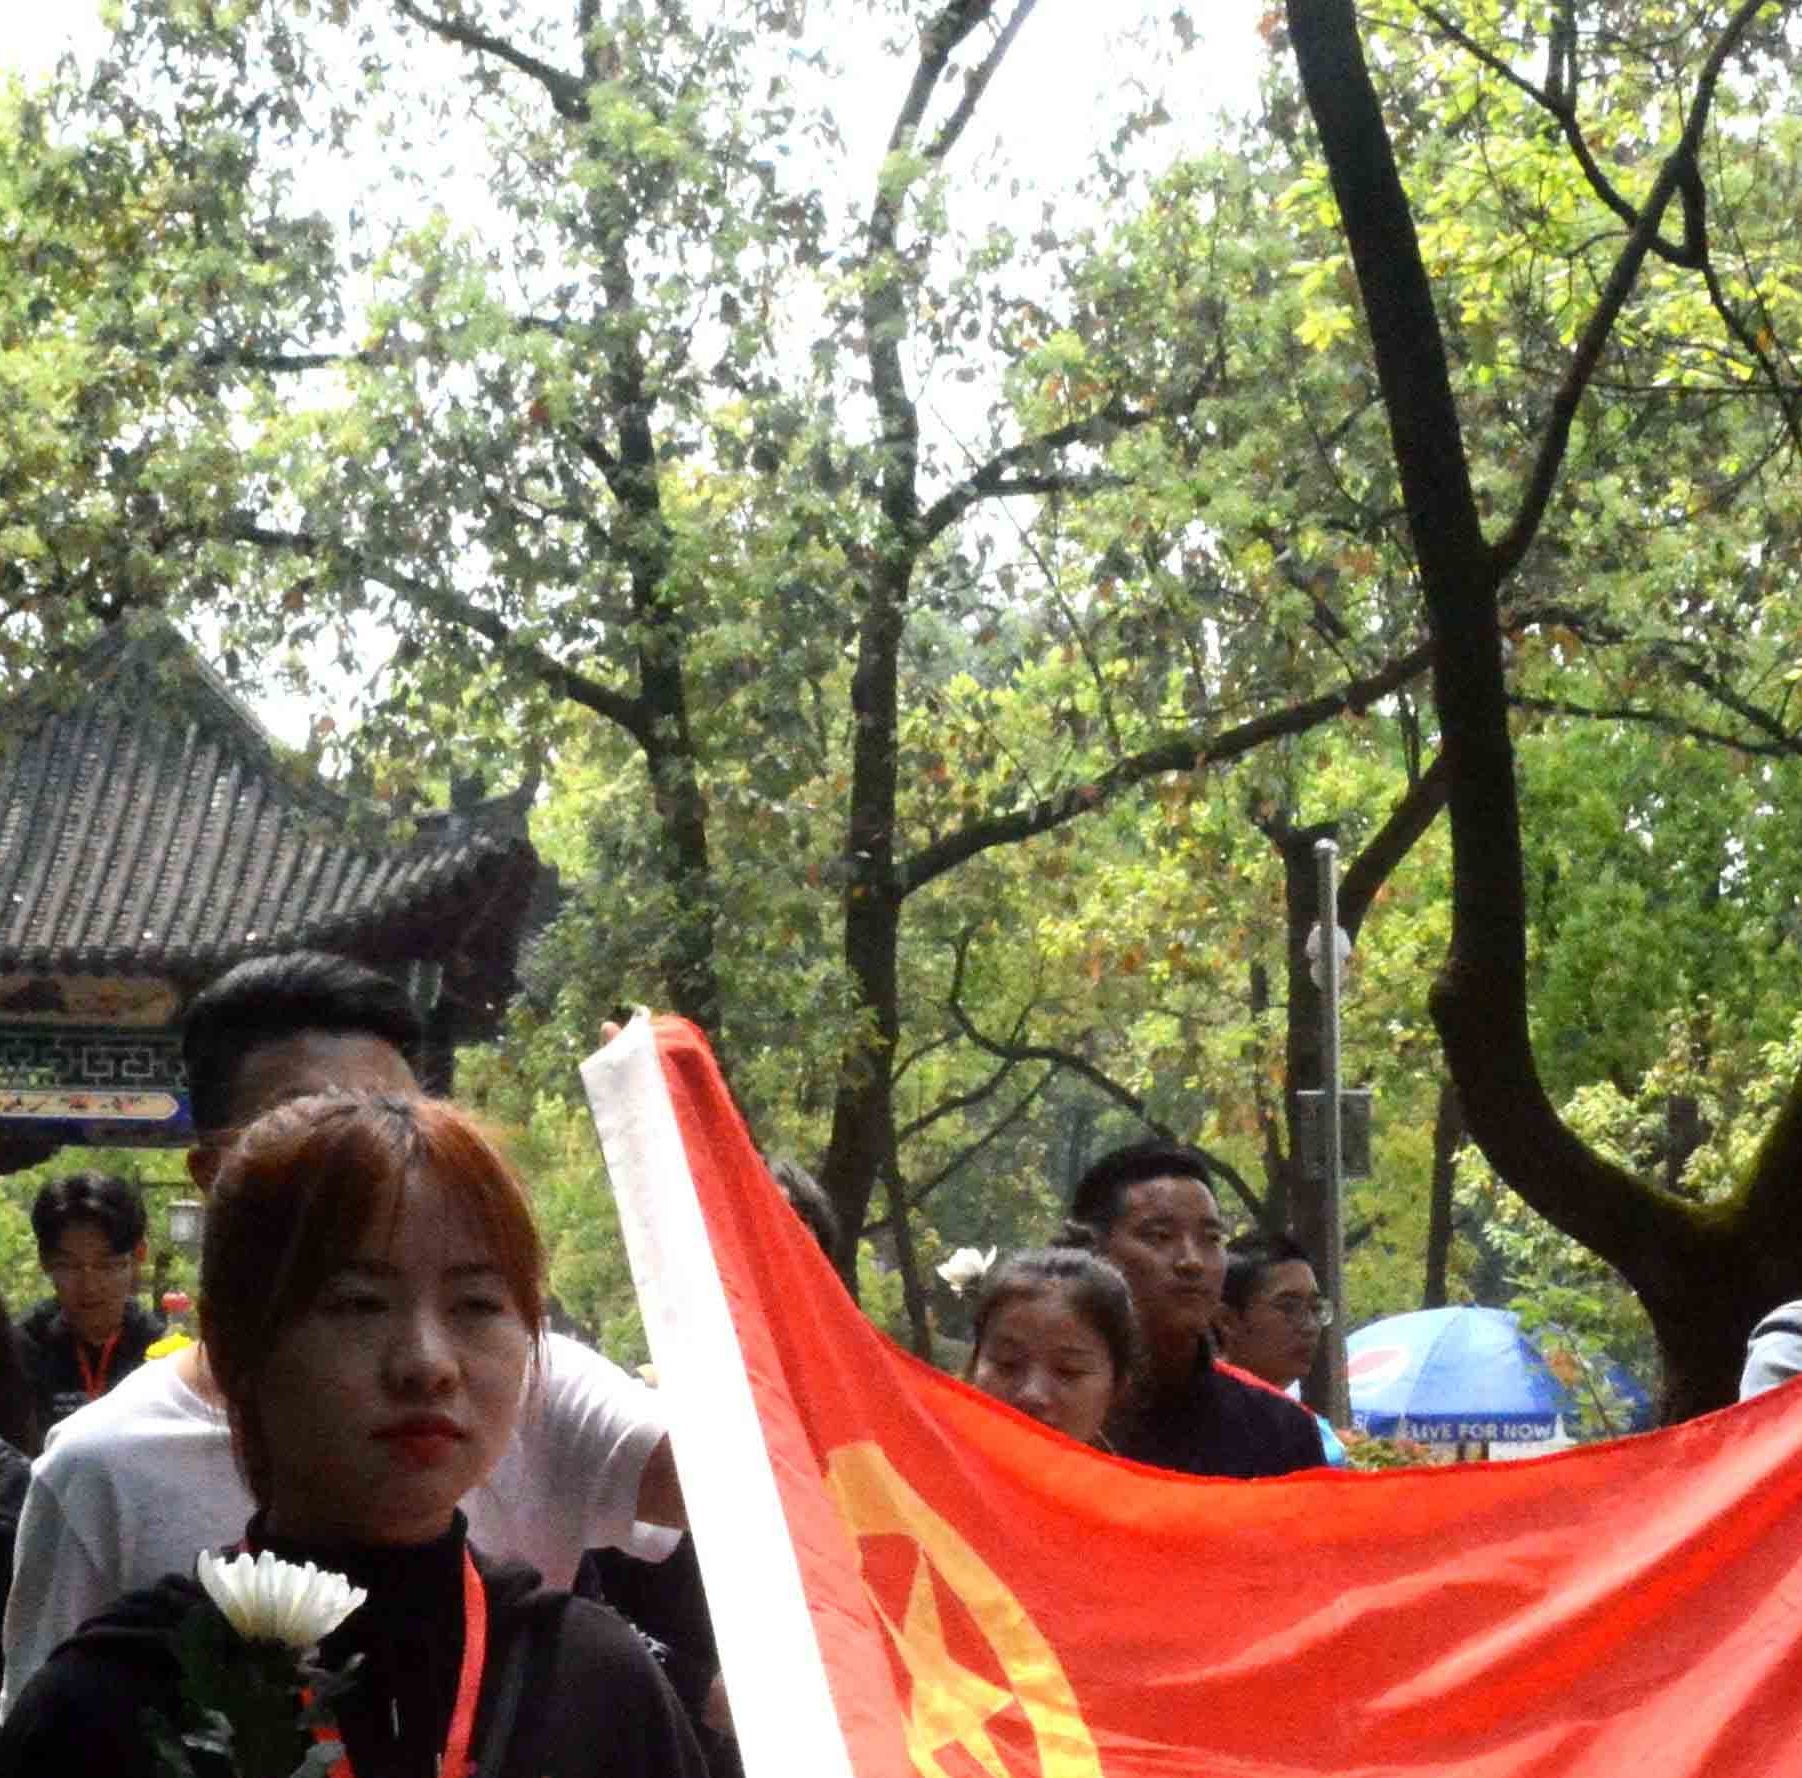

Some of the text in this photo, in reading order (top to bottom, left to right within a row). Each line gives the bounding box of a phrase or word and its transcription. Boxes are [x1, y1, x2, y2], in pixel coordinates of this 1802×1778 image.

[1411, 1423, 1550, 1439] LIVE FOR NOW
